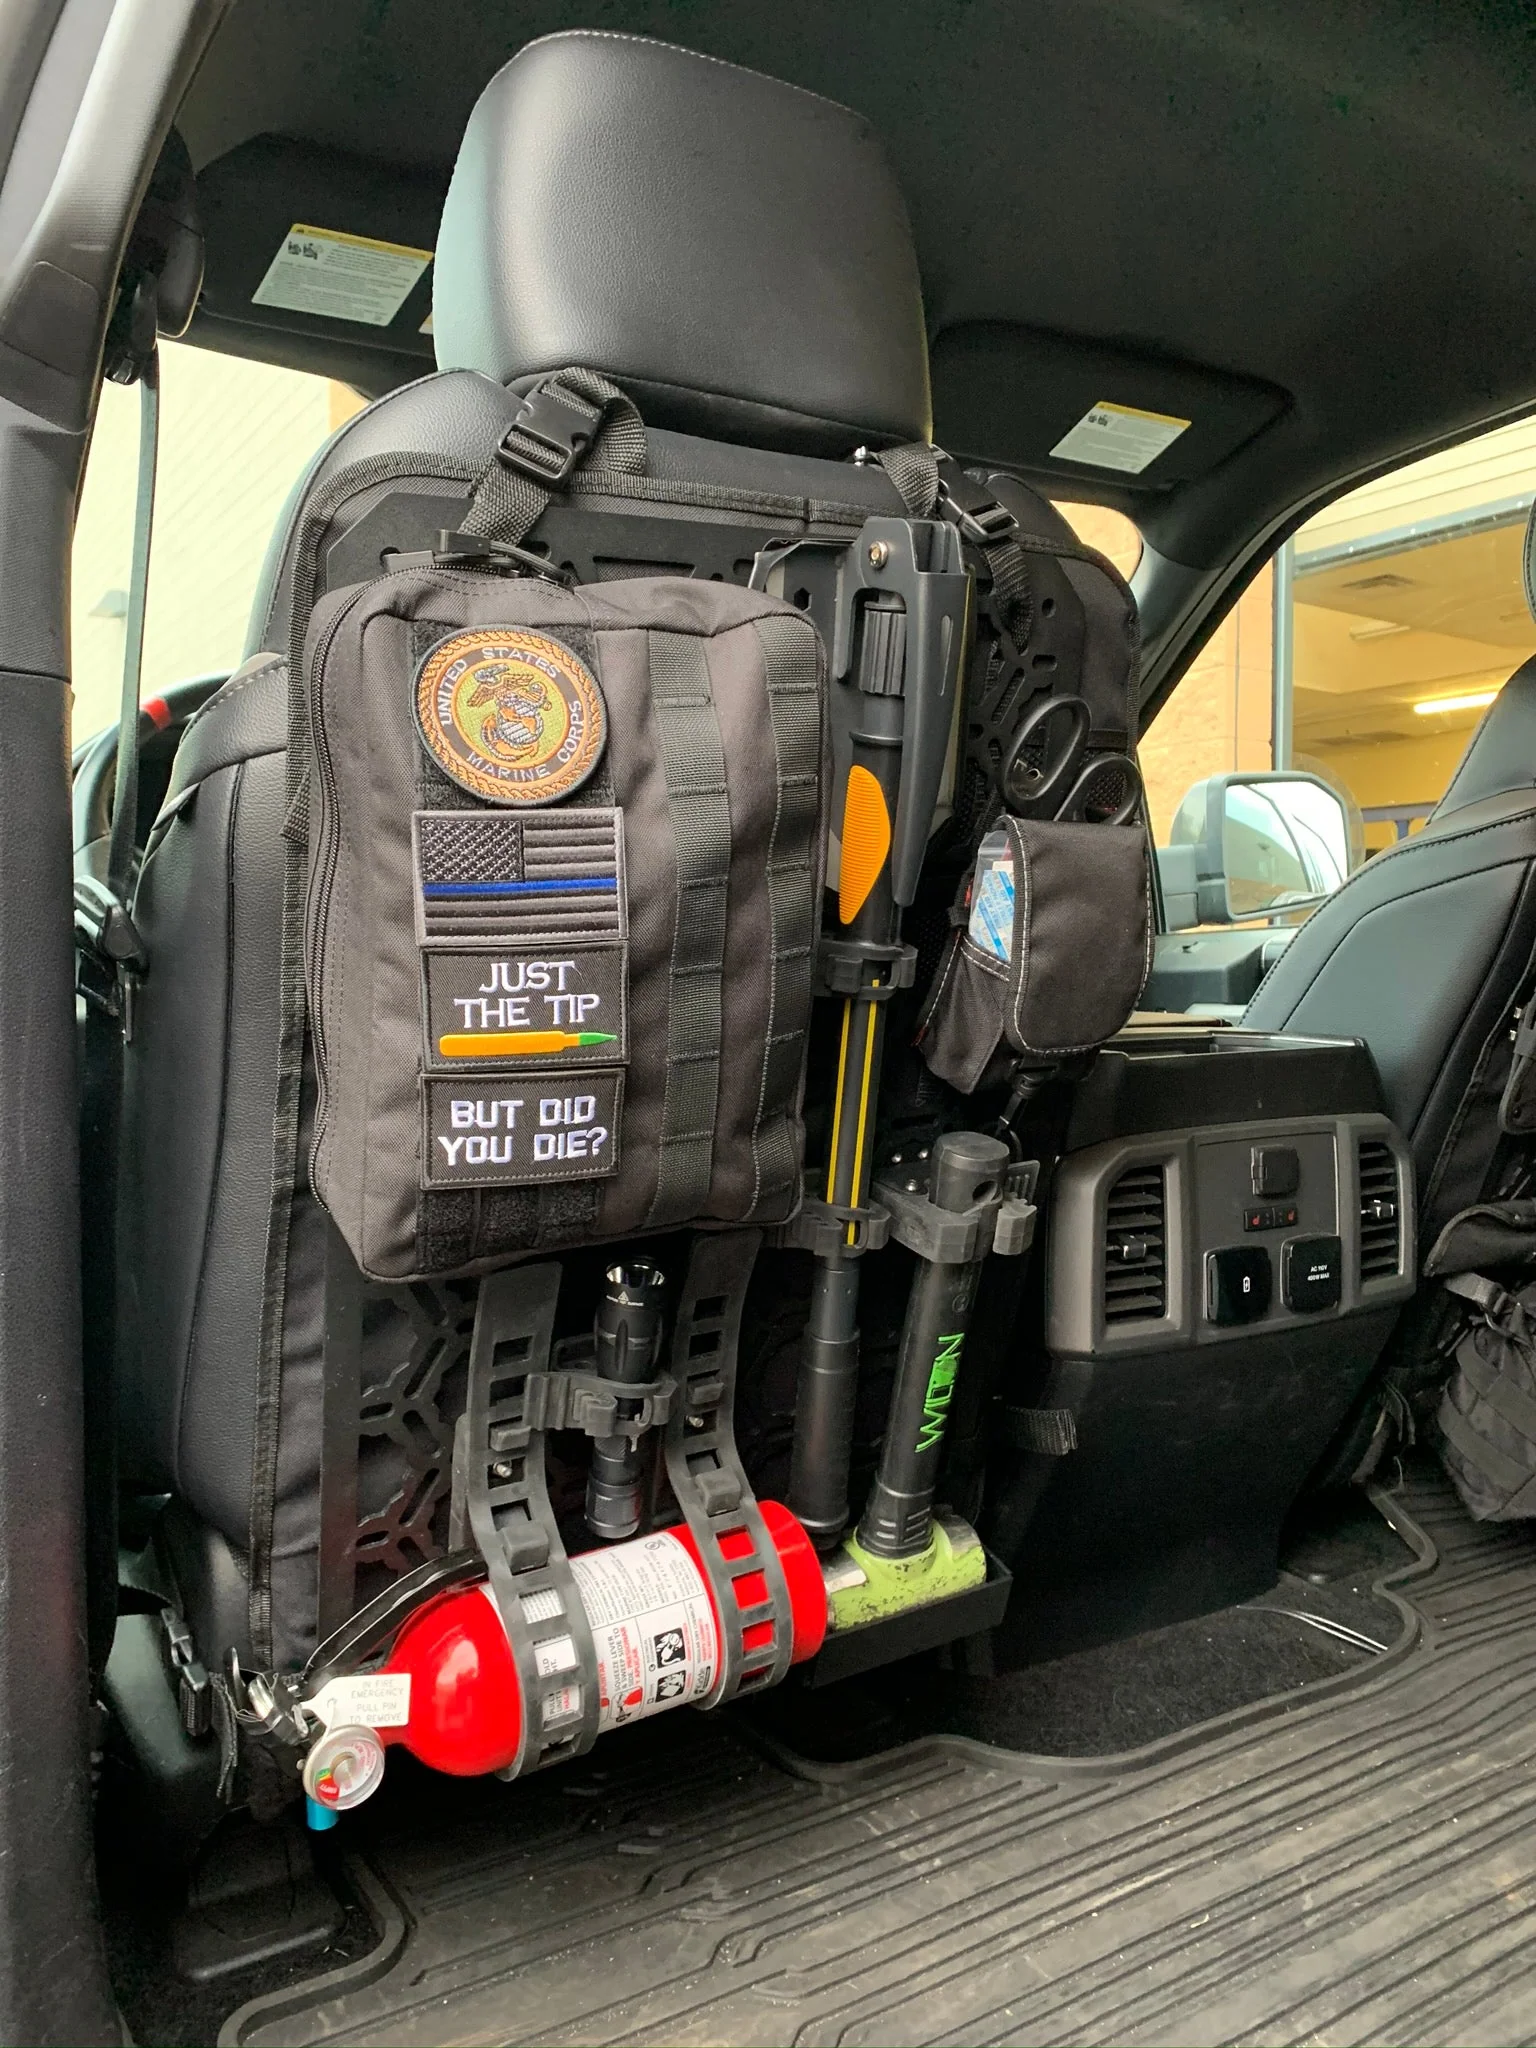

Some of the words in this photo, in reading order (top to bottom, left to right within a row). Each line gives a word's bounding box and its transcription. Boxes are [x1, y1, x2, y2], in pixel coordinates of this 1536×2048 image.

[436, 658, 468, 726] UNITED
[482, 646, 562, 679] STATES
[466, 751, 550, 782] MARINE
[558, 699, 582, 763] CORPS
[479, 960, 575, 993] JUST
[453, 996, 531, 1028] THE
[544, 993, 601, 1025] TIP
[450, 1099, 524, 1129] BUT
[539, 1095, 596, 1126] DID
[437, 1135, 513, 1167] YOU
[533, 1126, 608, 1162] DIE?
[1310, 1265, 1317, 1273] AC
[608, 1635, 617, 1661] LEVER
[351, 1687, 404, 1699] EMERGENCY
[375, 1679, 395, 1688] FIRE
[356, 1703, 378, 1712] PULL
[382, 1702, 397, 1711] PIN
[366, 1712, 402, 1722] REMOVE
